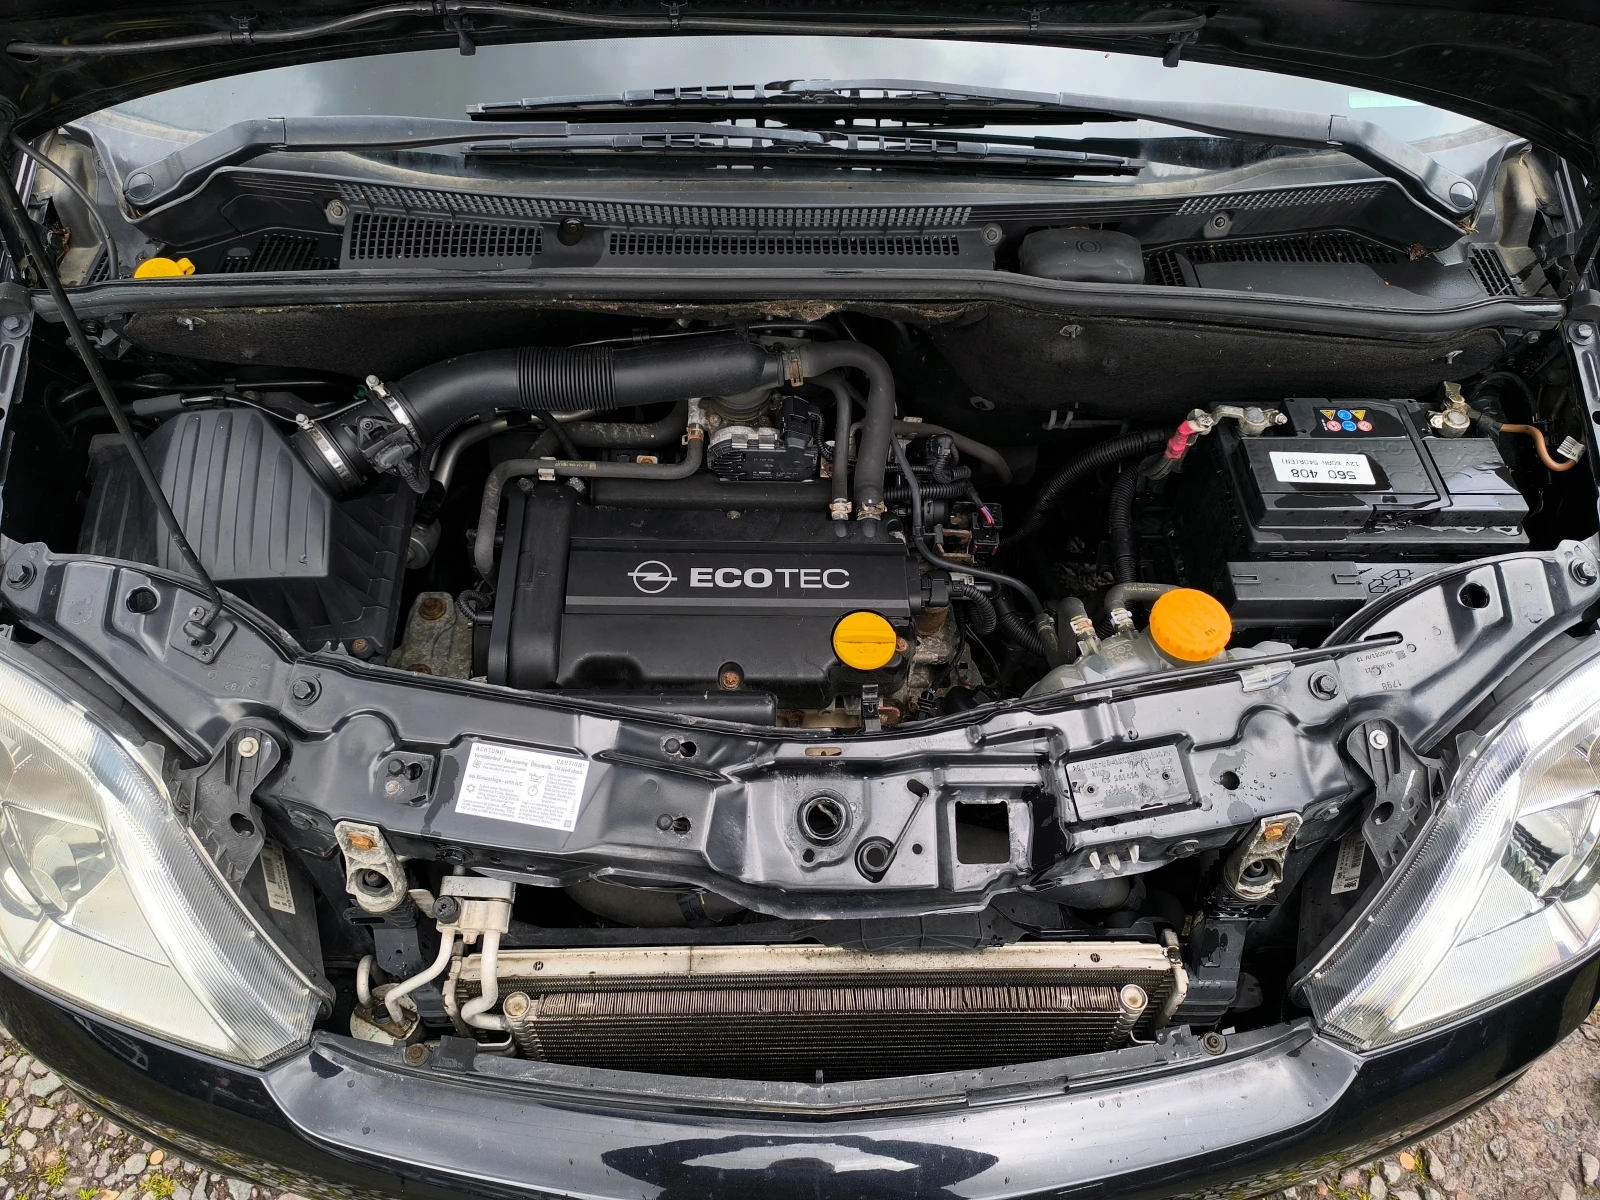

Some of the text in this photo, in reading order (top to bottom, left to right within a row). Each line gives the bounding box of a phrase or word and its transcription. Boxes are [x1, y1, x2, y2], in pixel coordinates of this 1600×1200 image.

[1290, 468, 1357, 480] 560 408
[690, 567, 850, 588] ECOTEC
[475, 746, 506, 755] ACHTUNG!
[557, 759, 585, 768] CAUTION!
